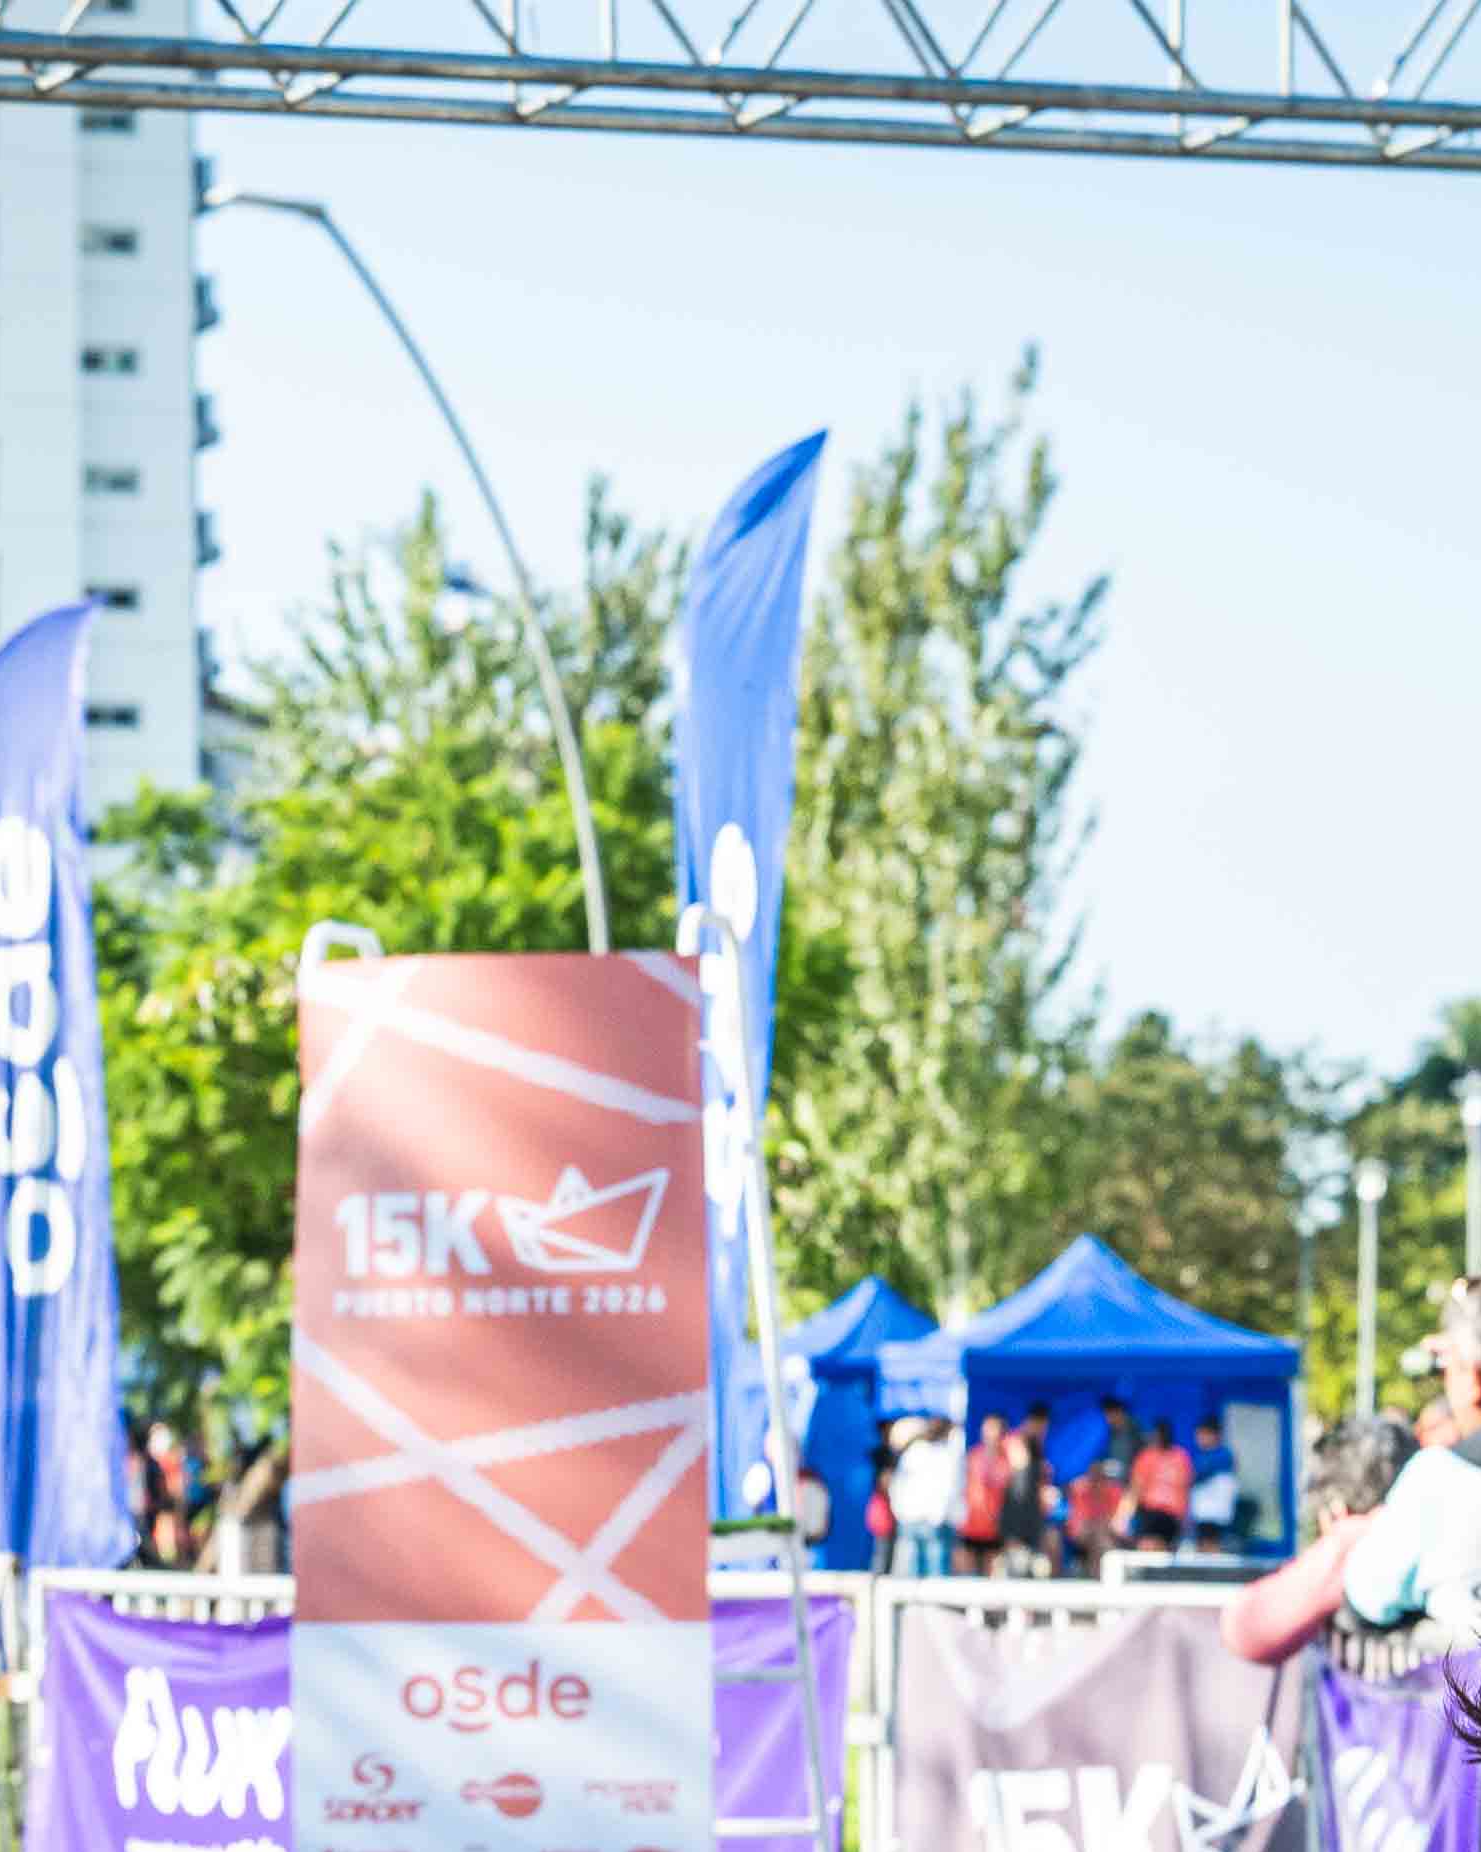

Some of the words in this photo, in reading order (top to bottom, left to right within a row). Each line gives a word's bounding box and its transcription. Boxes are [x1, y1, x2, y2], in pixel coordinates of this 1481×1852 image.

[334, 1190, 493, 1278] 15K
[463, 1285, 571, 1315] NORTE
[584, 1284, 667, 1314] 2026
[403, 1659, 591, 1734] osde
